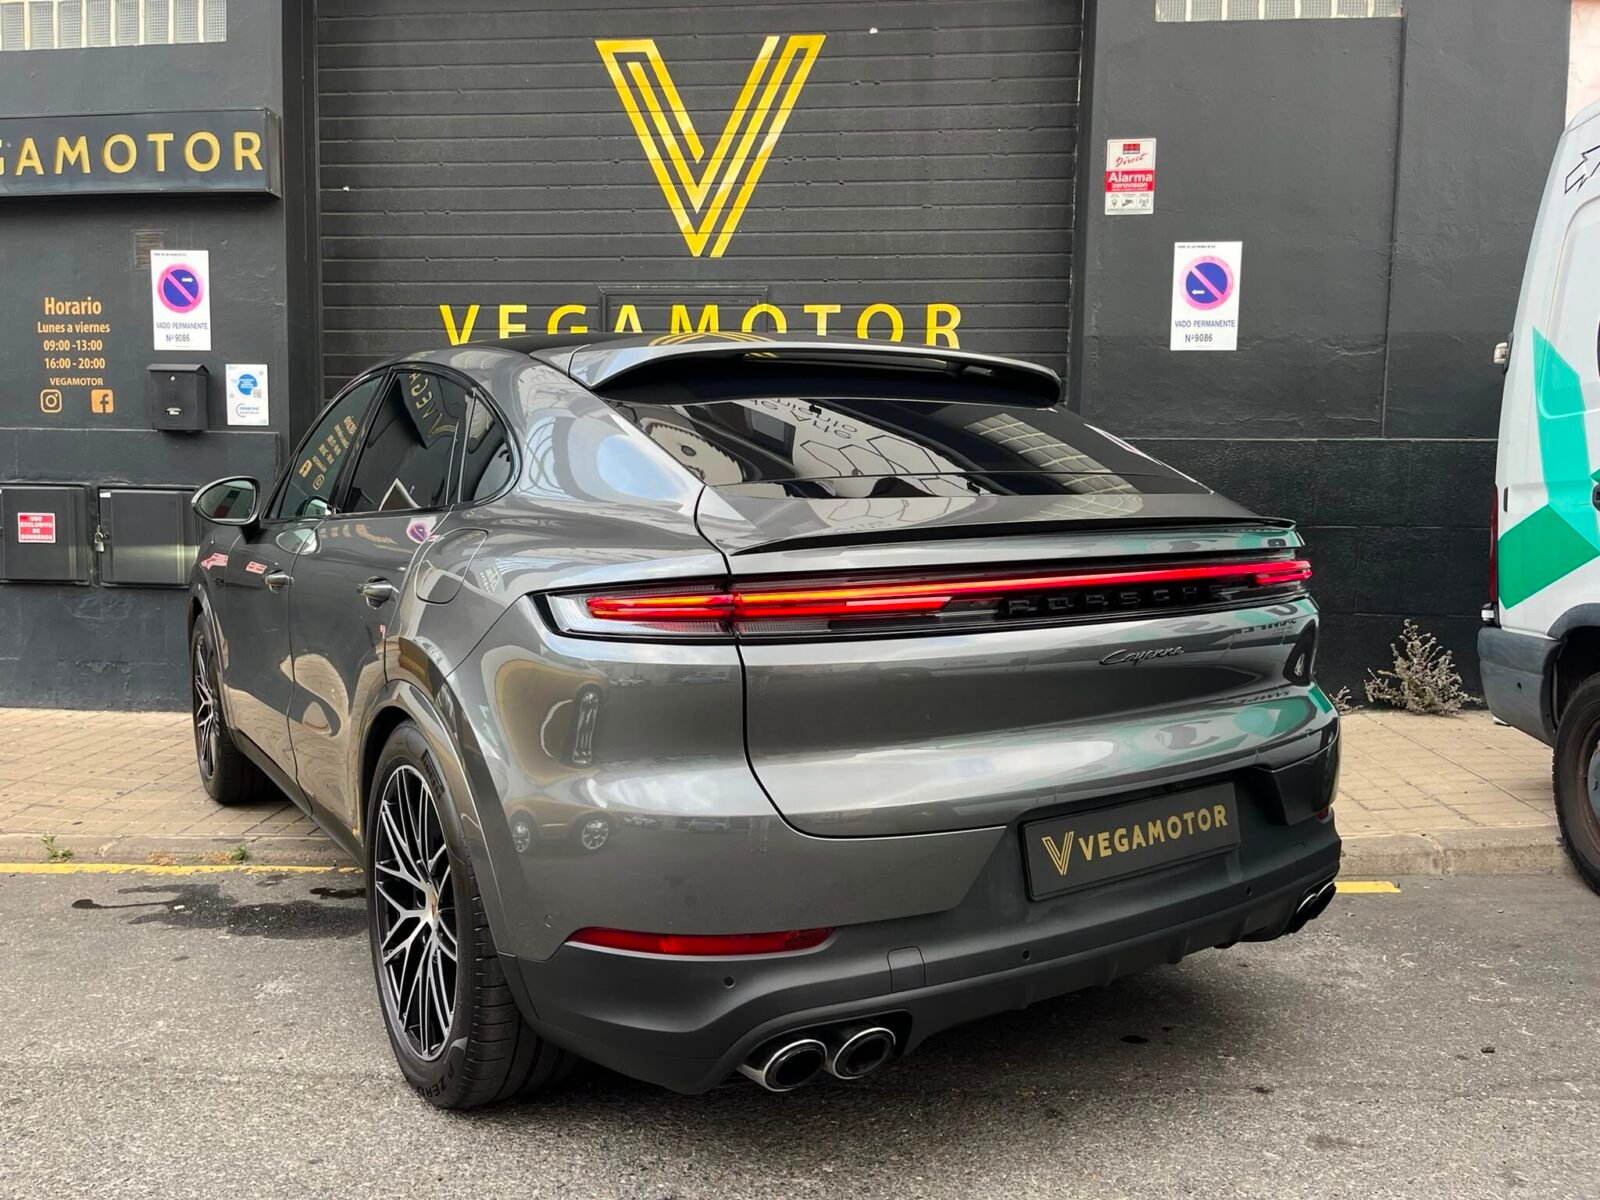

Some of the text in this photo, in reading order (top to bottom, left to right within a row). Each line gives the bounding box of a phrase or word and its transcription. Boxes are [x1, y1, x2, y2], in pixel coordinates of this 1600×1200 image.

[0, 131, 263, 176] AMOTOR
[1108, 172, 1153, 182] Alarma
[44, 296, 102, 315] Horario
[37, 321, 110, 333] Lunes a viernes
[172, 322, 208, 330] PERMANENTE
[439, 303, 961, 349] VEGAMOTOR
[1174, 319, 1236, 328] VADO PERMANENTE
[43, 339, 71, 351] 09:00
[44, 358, 71, 369] 16:00
[78, 358, 106, 369] 20:00
[49, 377, 104, 386] VEGAMOTOR
[1078, 804, 1228, 861] VEGAMOTOR
